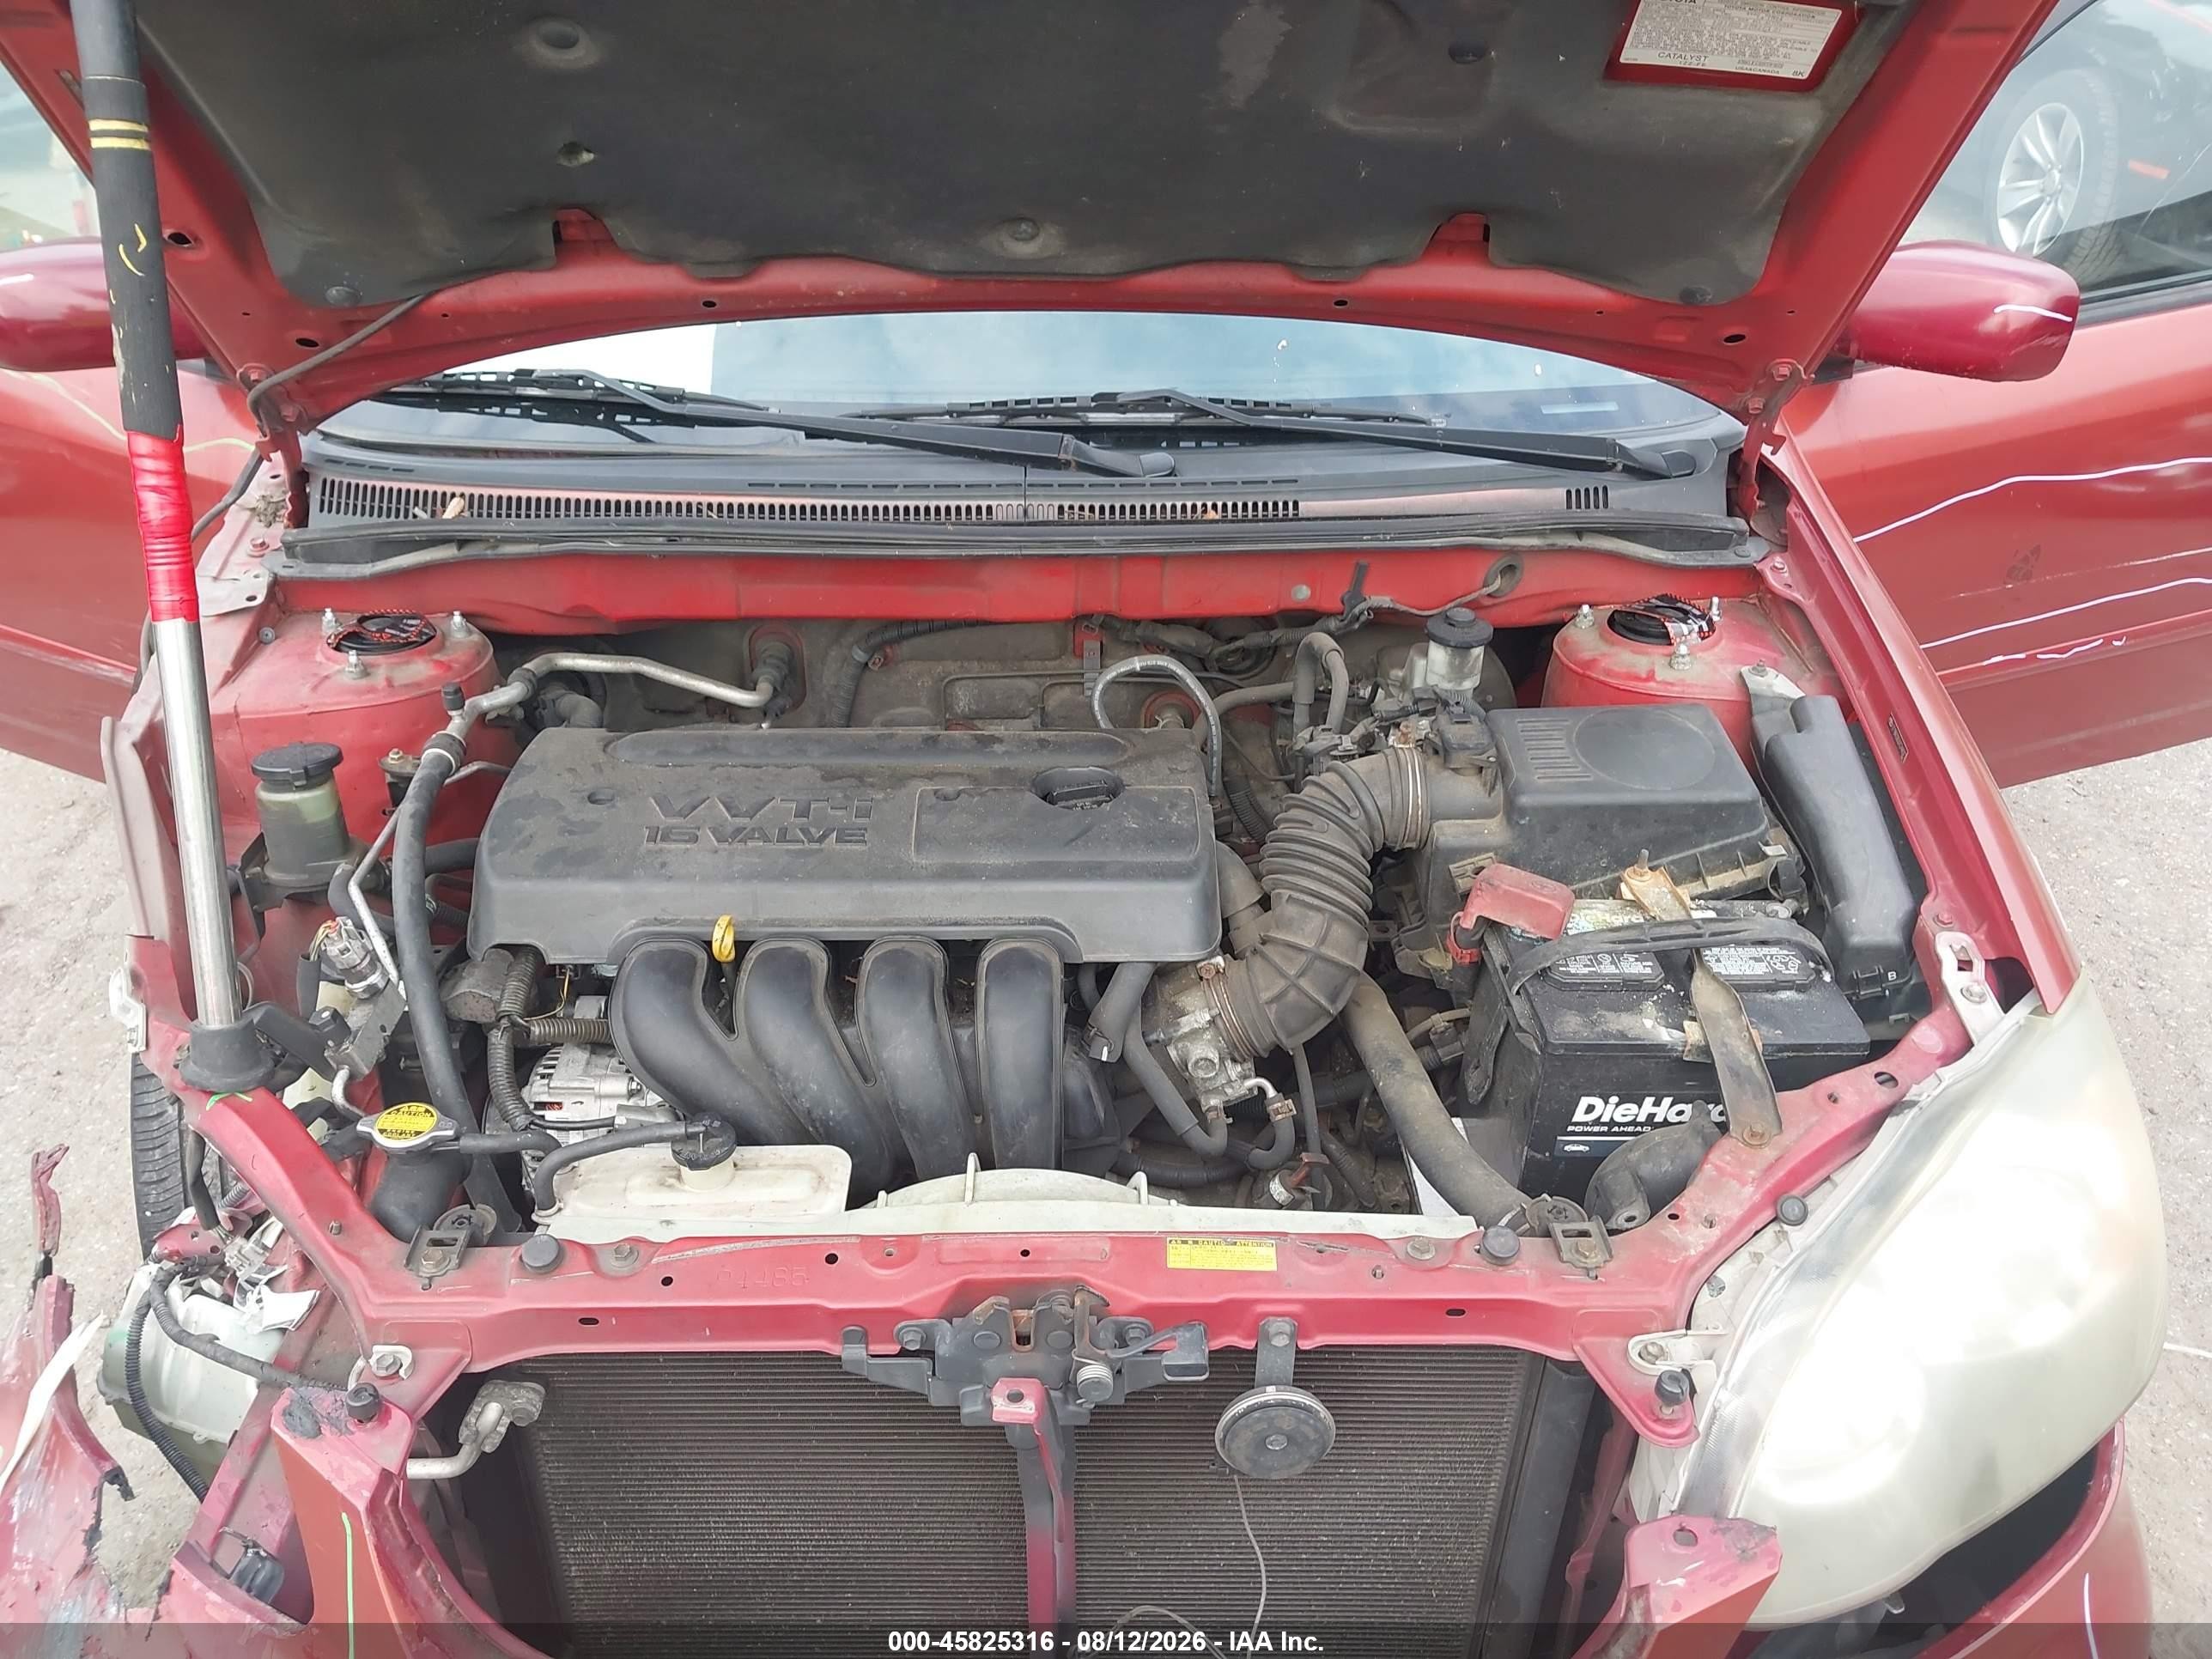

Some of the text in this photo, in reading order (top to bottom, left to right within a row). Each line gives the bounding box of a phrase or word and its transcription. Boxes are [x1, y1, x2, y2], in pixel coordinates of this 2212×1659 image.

[1657, 52, 1709, 63] CATALYST
[644, 825, 869, 848] 16 VALVE
[1887, 971, 1897, 981] B
[1571, 1095, 1728, 1124] DieHa
